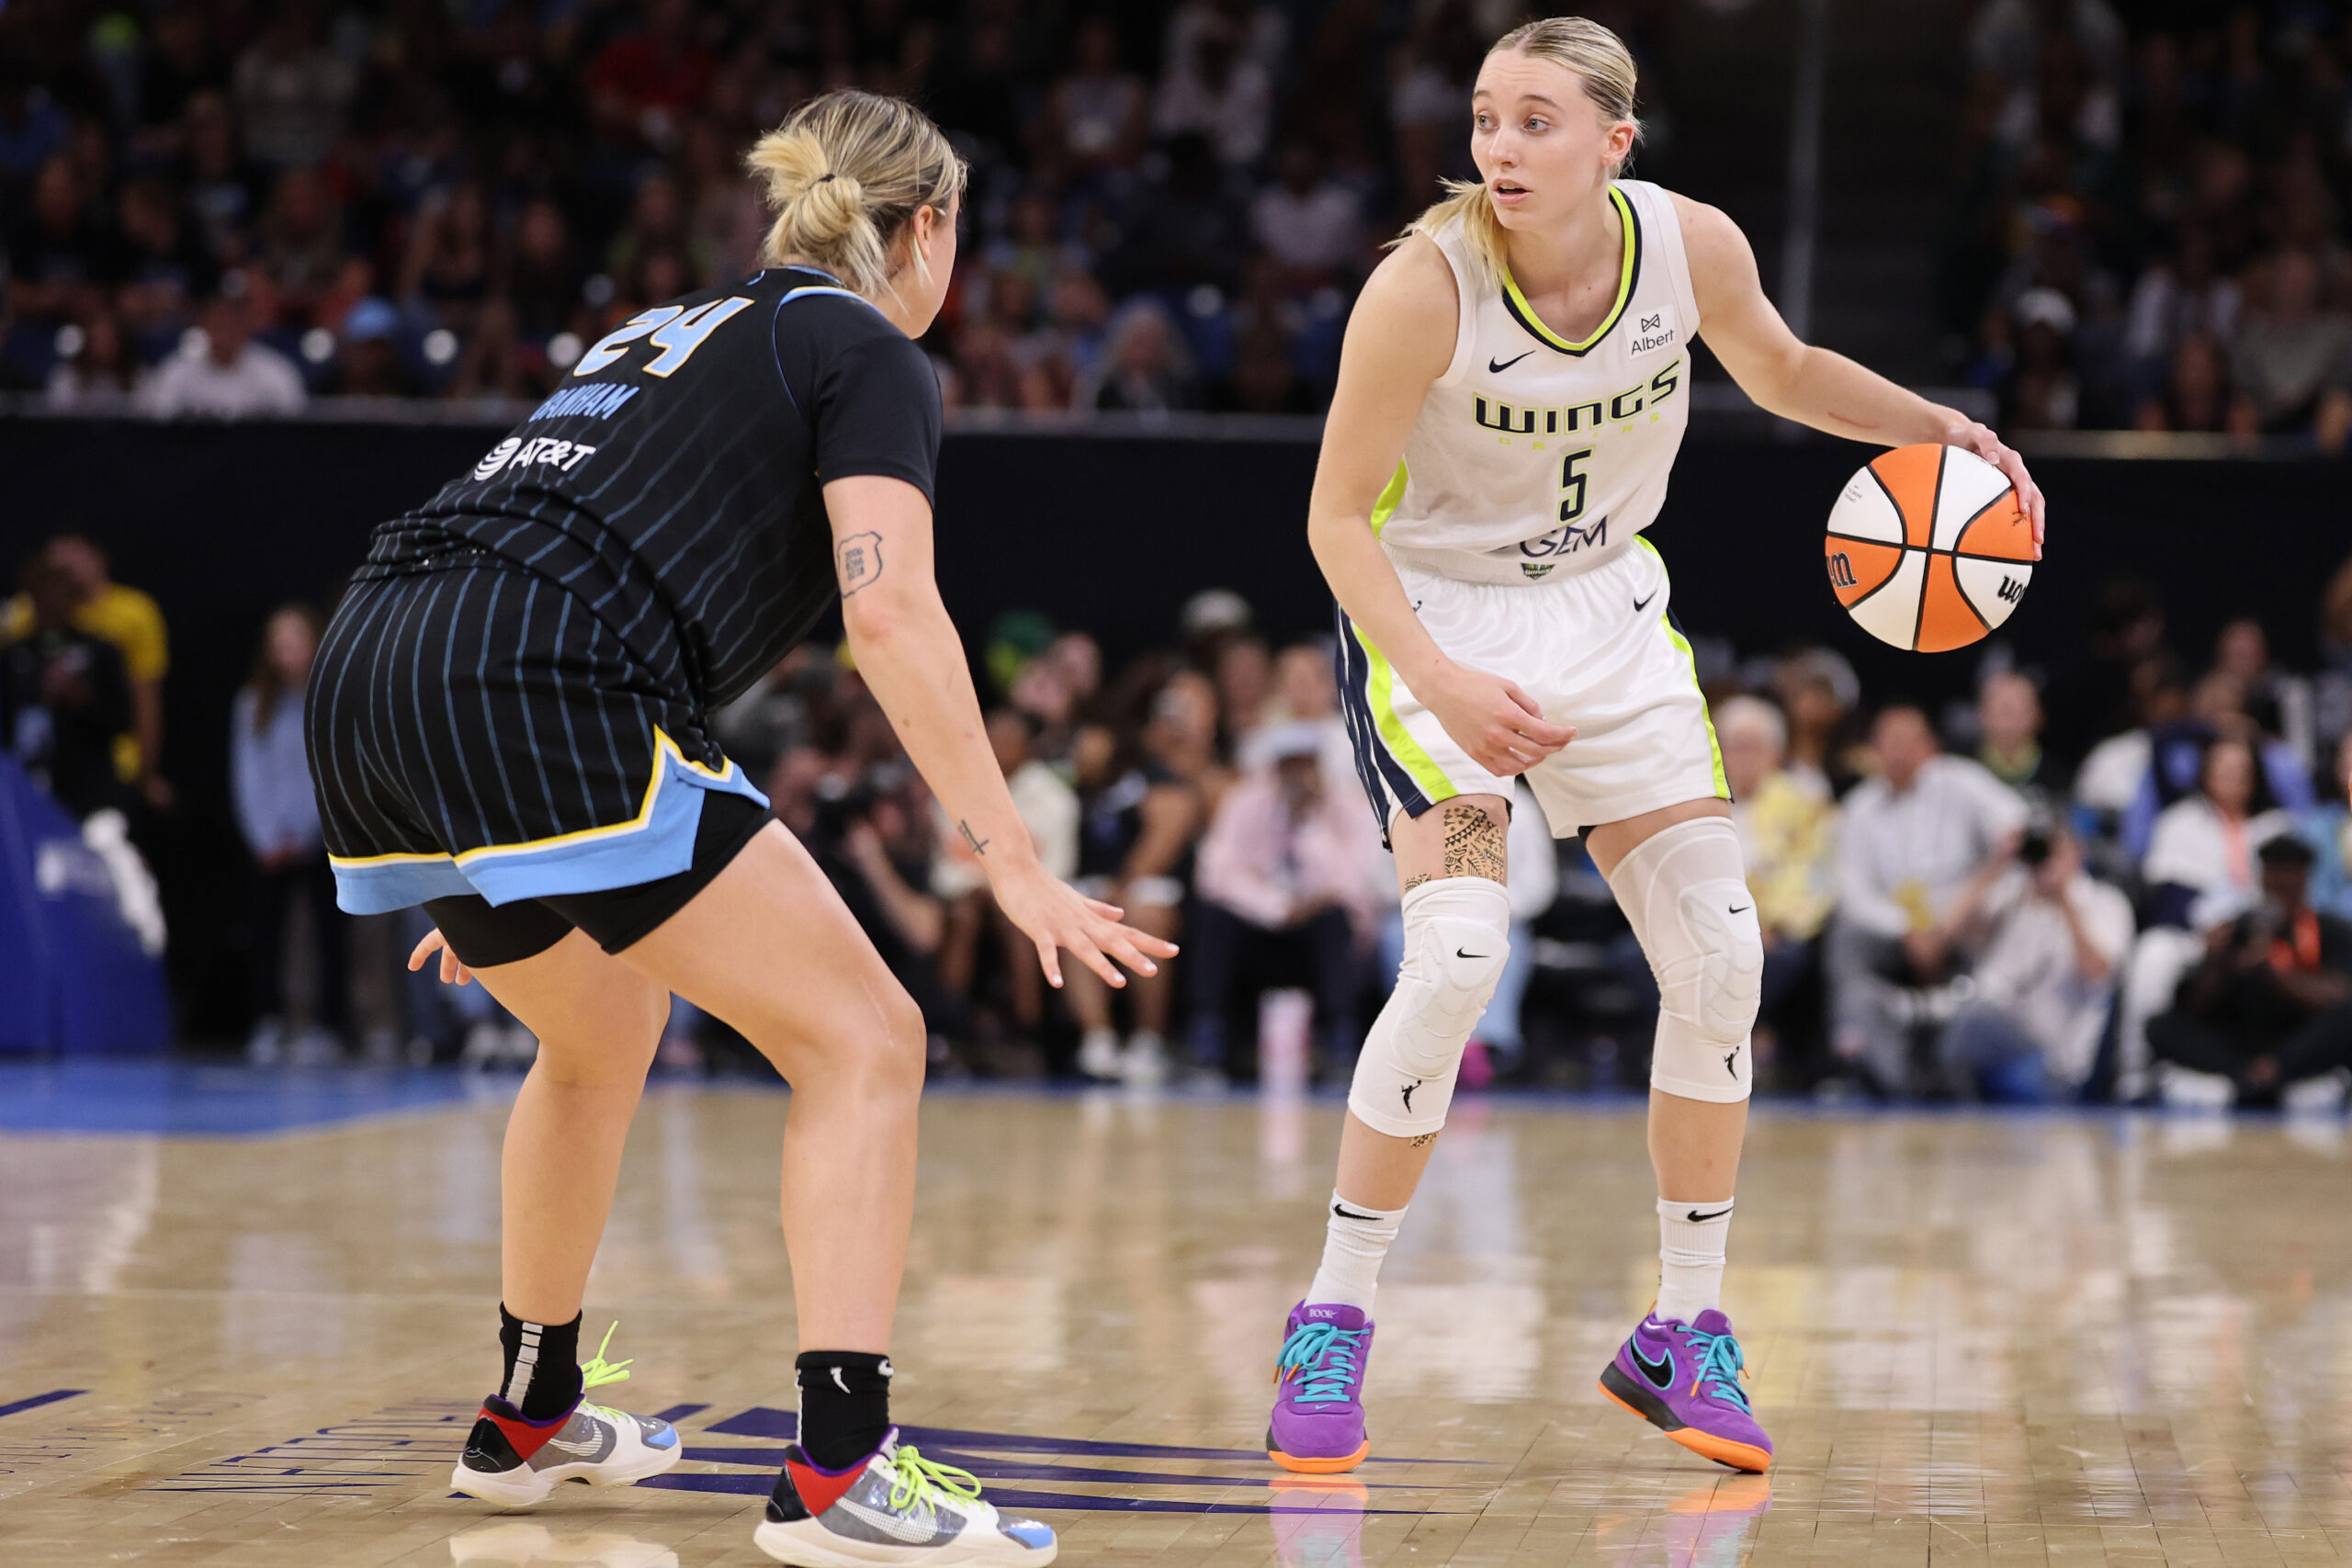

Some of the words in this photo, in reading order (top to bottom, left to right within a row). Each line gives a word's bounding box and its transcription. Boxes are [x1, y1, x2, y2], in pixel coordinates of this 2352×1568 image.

[573, 296, 755, 378] 24
[1631, 329, 1676, 355] Albert
[1473, 355, 1683, 436] WINGS
[507, 437, 597, 471] AT&T
[1557, 446, 1595, 525] 5
[1520, 515, 1608, 558] GEM
